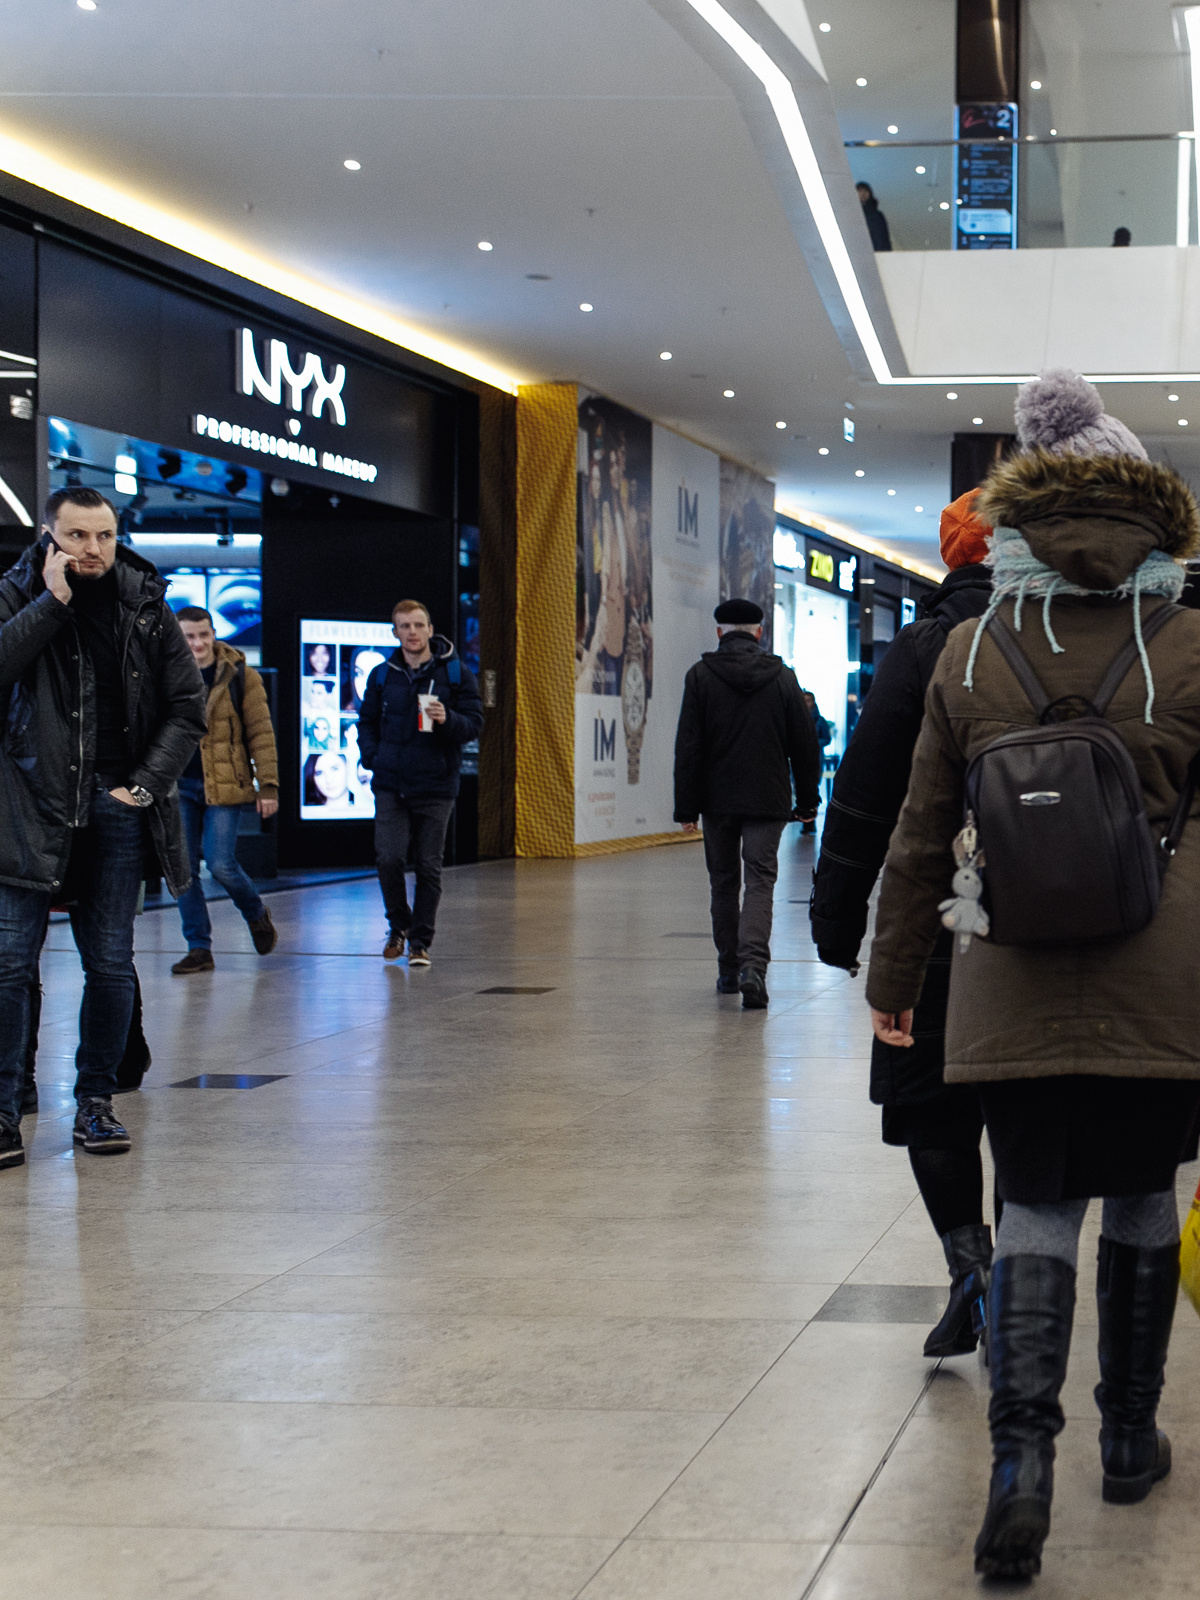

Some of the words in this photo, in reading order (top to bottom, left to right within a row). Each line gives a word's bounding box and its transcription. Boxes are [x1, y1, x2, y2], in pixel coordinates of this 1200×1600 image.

[995, 109, 1011, 128] 2
[241, 327, 347, 427] NYX
[195, 413, 318, 467] PROFESSIONAL
[321, 451, 378, 483] MAKEUP
